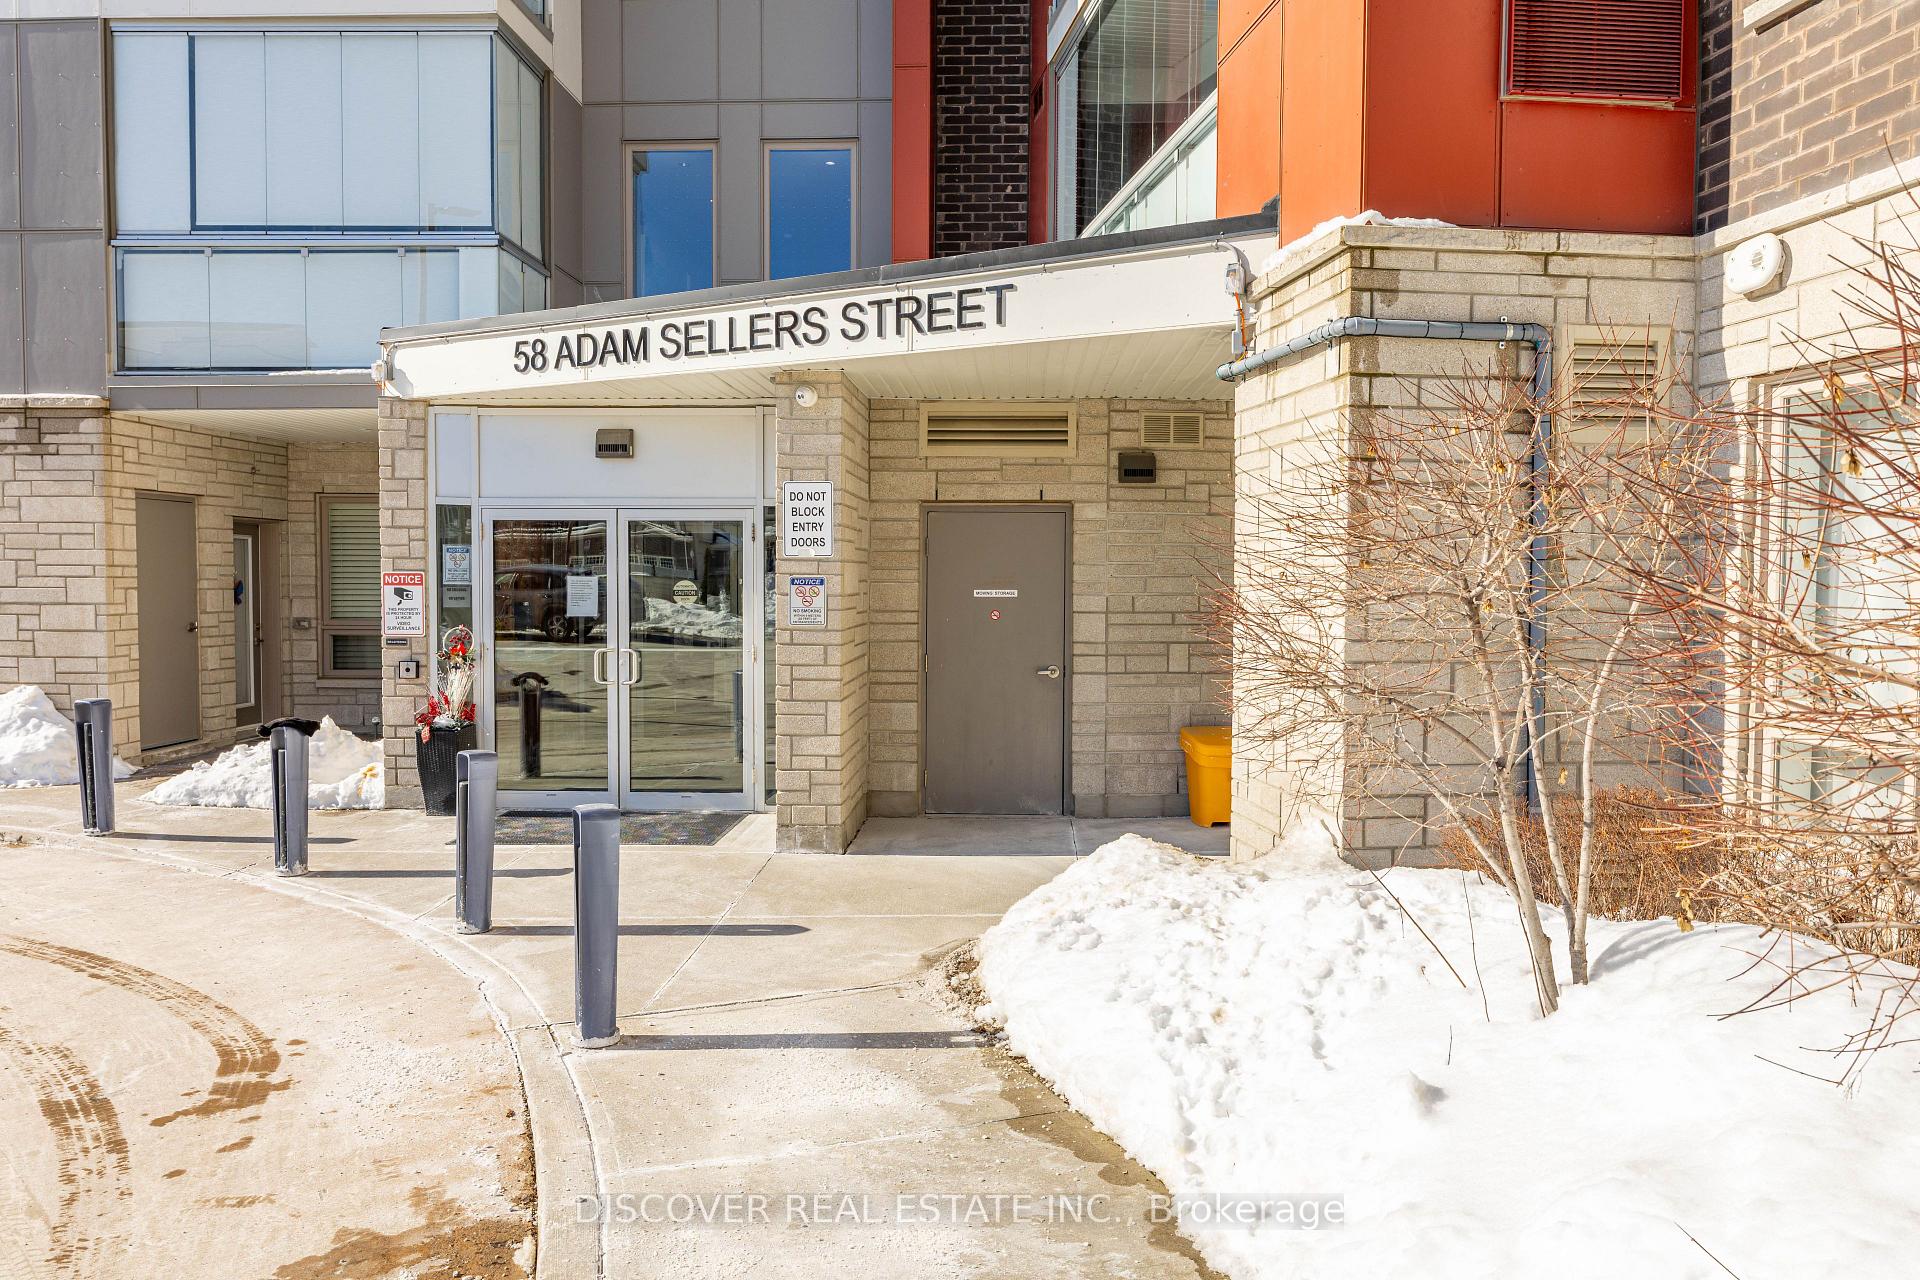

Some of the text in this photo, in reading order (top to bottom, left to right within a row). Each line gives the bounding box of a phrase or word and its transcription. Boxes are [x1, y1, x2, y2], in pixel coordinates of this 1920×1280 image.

[514, 283, 1016, 374] 58 ADAM SELLERS STREET
[789, 491, 827, 502] DO NOT
[791, 506, 825, 517] BLOCK
[792, 522, 824, 532] ENTRY
[791, 537, 826, 547] DOORS
[384, 575, 422, 584] NOTICE
